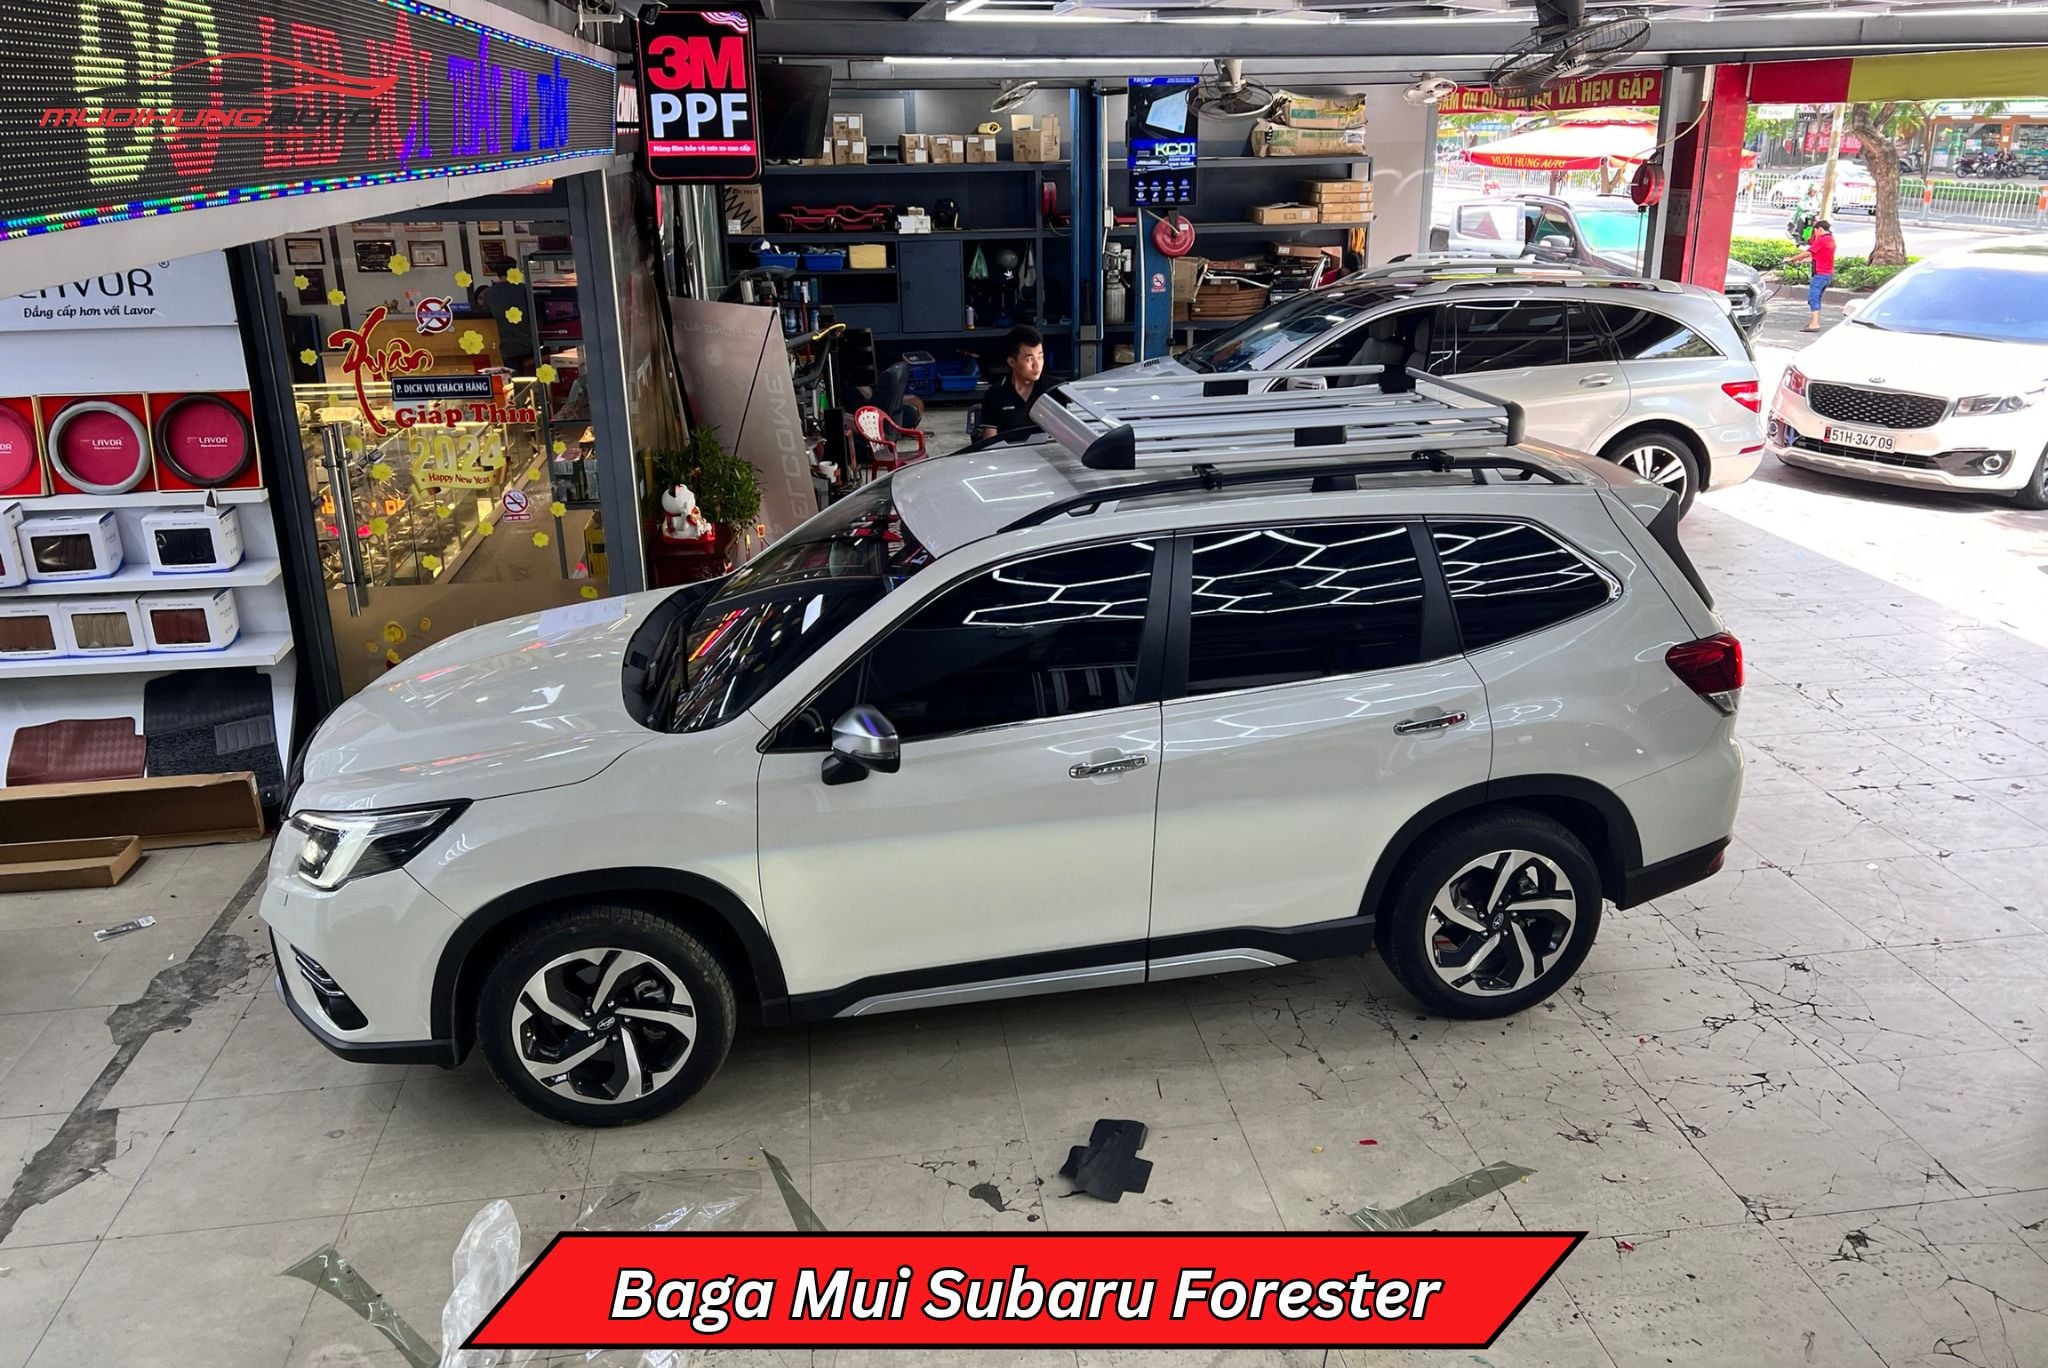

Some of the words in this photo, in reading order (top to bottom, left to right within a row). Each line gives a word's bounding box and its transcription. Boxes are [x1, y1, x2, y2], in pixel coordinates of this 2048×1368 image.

[648, 35, 747, 90] 3M
[650, 93, 749, 138] PPF
[56, 304, 77, 319] cấp
[80, 307, 101, 317] hơn
[103, 305, 121, 316] với
[124, 305, 156, 316] Lavor
[404, 383, 422, 395] DỊCH
[424, 383, 436, 394] VỤ
[465, 380, 488, 392] HÀNG
[395, 402, 463, 429] Giáp
[467, 400, 537, 424] Thìn
[408, 434, 507, 473] 2024
[428, 473, 453, 483] Happy
[454, 473, 473, 484] New
[473, 475, 490, 484] Year
